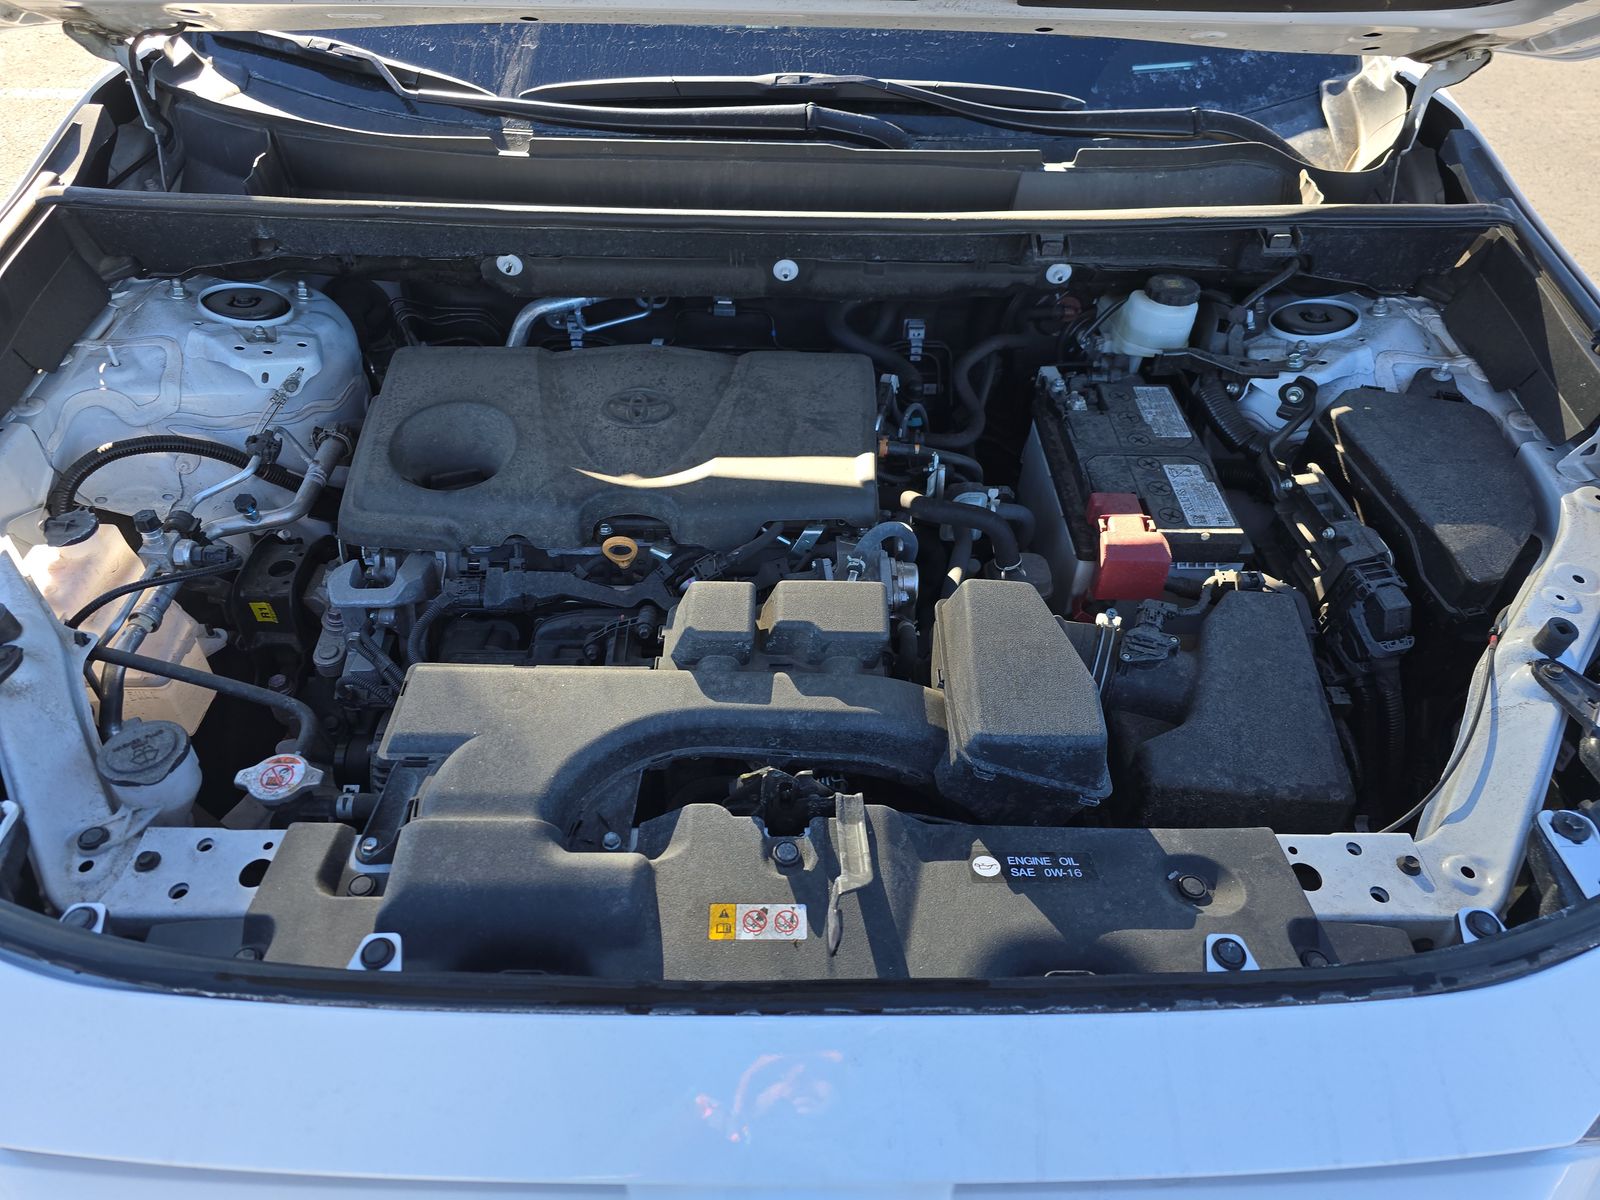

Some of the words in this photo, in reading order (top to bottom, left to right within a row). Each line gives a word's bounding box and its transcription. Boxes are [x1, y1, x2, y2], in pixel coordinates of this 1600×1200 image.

[1007, 856, 1052, 866] ENGINE
[1058, 857, 1080, 866] OIL
[1010, 867, 1036, 877] SAE
[1044, 868, 1083, 878] 0W-16
